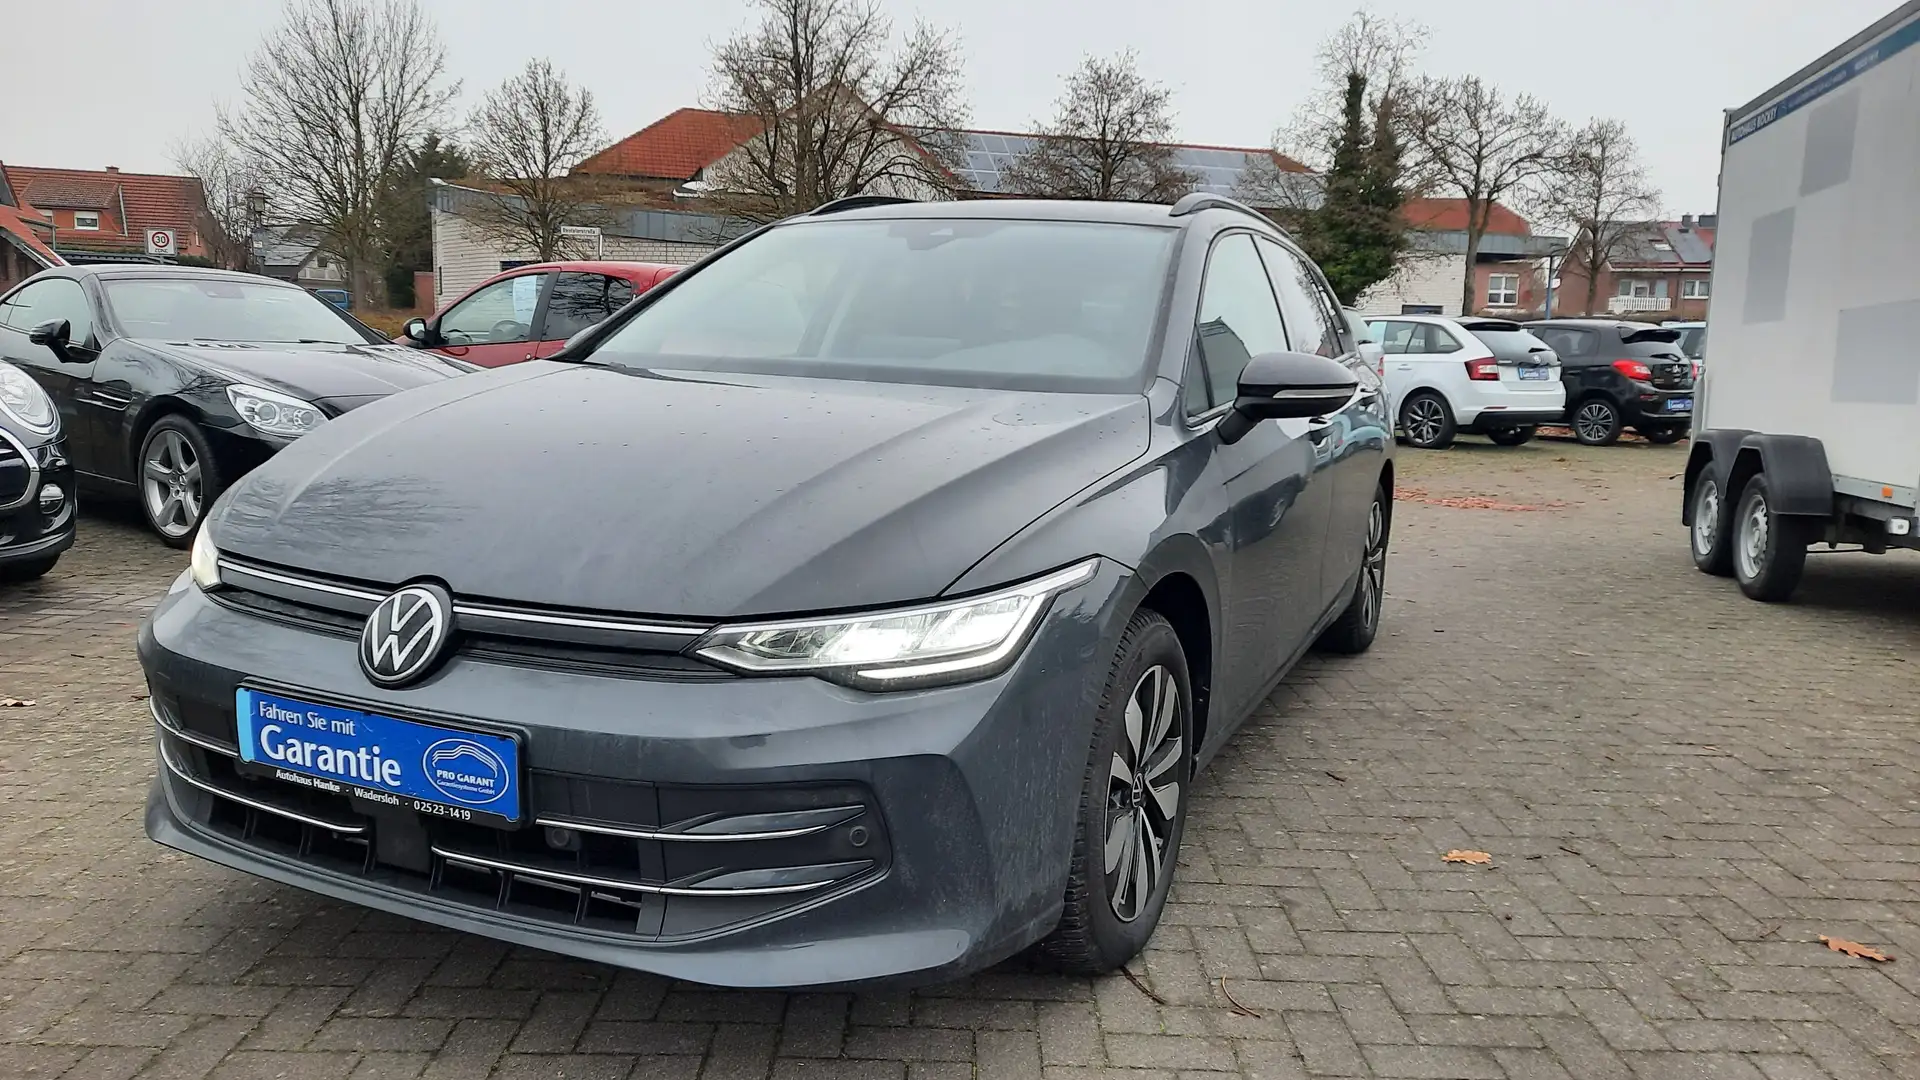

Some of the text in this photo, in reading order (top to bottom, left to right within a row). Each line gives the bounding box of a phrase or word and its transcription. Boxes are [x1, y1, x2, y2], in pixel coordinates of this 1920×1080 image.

[155, 235, 166, 244] 30
[259, 701, 356, 737] Fahren Sie mit
[259, 724, 401, 787] Garantie
[275, 769, 472, 821] Autohaus Hanke Wadersloh 02523-1419
[436, 769, 495, 788] PRO GARANT
